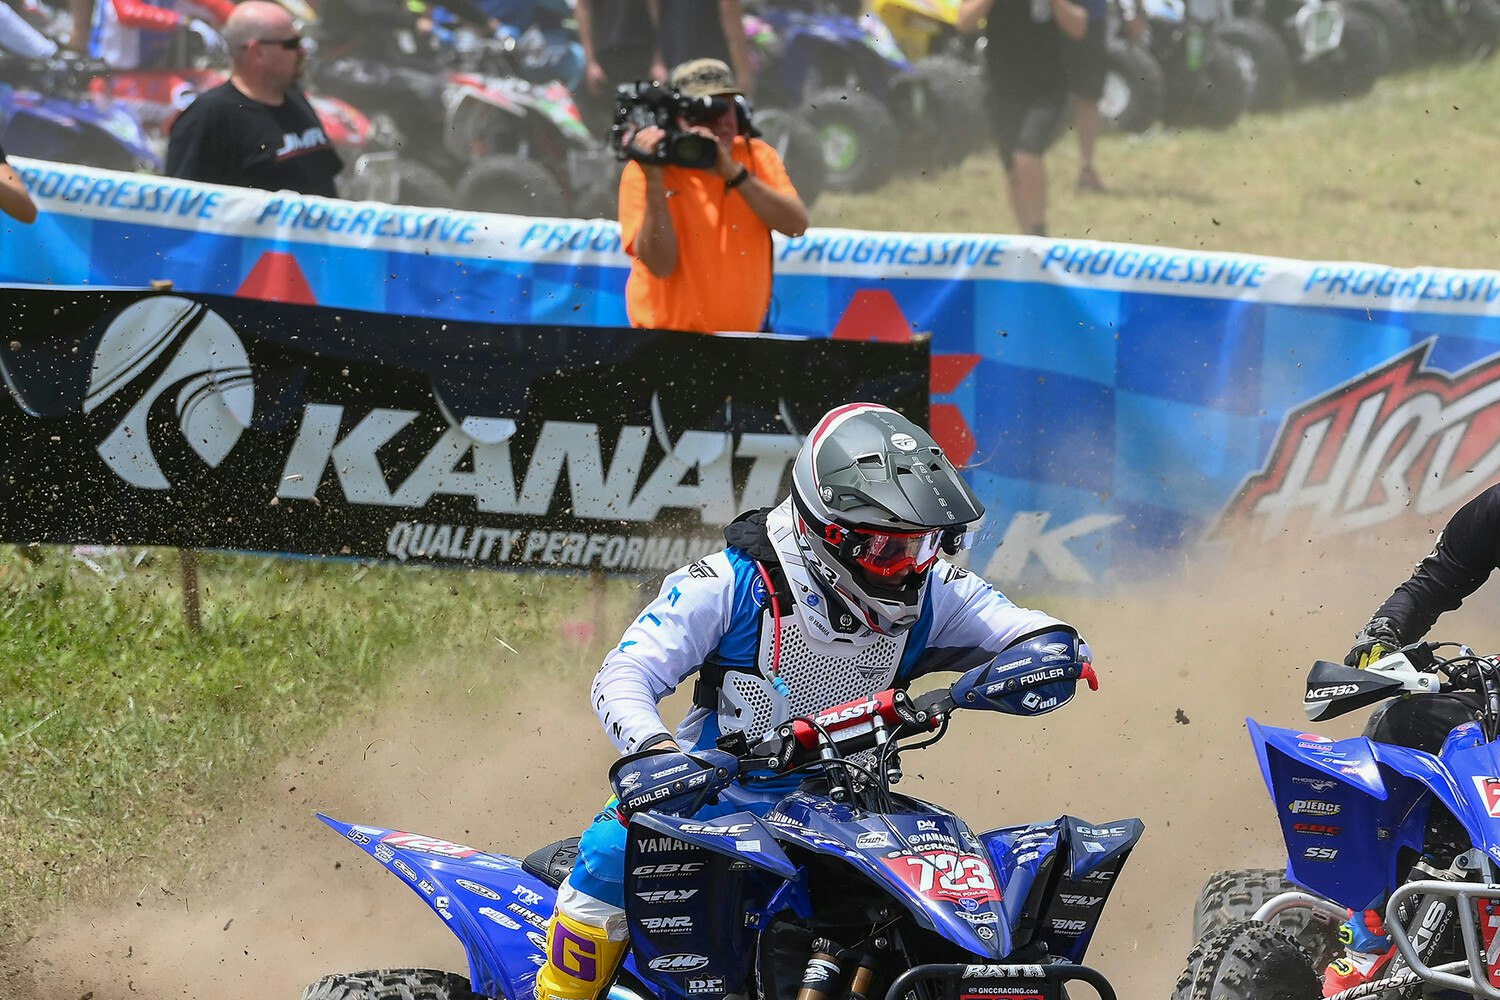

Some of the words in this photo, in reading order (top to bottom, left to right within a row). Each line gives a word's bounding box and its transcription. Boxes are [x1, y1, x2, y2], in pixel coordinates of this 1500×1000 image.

[13, 165, 226, 220] ROGRESSIVE
[257, 198, 479, 246] PROGRESSIVE
[781, 234, 1006, 269] PROGRESSIVE
[1041, 245, 1266, 290] PROGRESSIVE
[278, 402, 796, 522] KANAT
[387, 522, 516, 562] QUALITY
[529, 532, 726, 572] PERFORMANC
[1020, 668, 1065, 686] FOWLER
[1305, 684, 1360, 699] ACERBIS
[812, 699, 881, 729] FASST
[629, 787, 671, 810] FOWLER
[1292, 799, 1341, 813] PIERCE
[637, 836, 700, 854] YAMA
[919, 832, 957, 845] YAMAHA
[1304, 847, 1339, 860] SSI
[632, 861, 706, 876] GBC
[906, 853, 995, 893] 723
[640, 915, 693, 929] BNR
[650, 955, 709, 970] FMF
[961, 964, 1046, 979] RATH
[688, 980, 723, 989] DP
